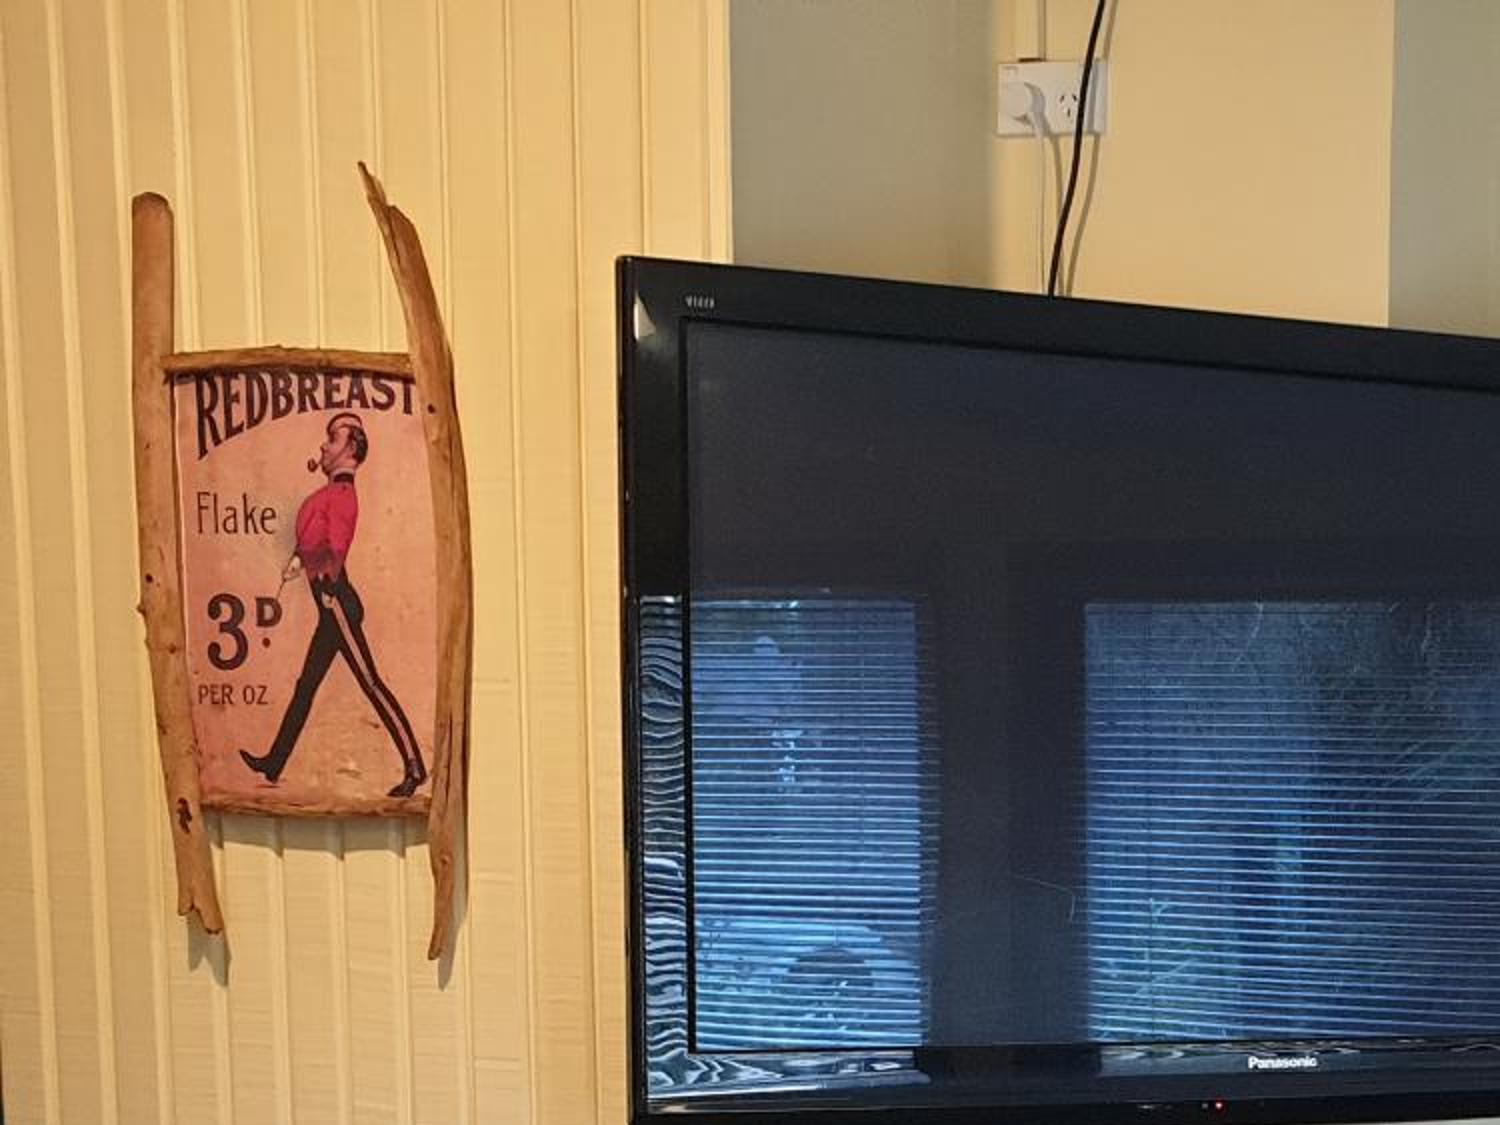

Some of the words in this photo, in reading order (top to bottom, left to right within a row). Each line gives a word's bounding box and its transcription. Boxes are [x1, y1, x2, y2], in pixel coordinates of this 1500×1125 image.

[195, 368, 416, 460] REDBREAST
[197, 491, 277, 535] Flake
[198, 684, 234, 705] PER
[242, 684, 269, 705] OZ
[1248, 1055, 1318, 1069] Panasonic
